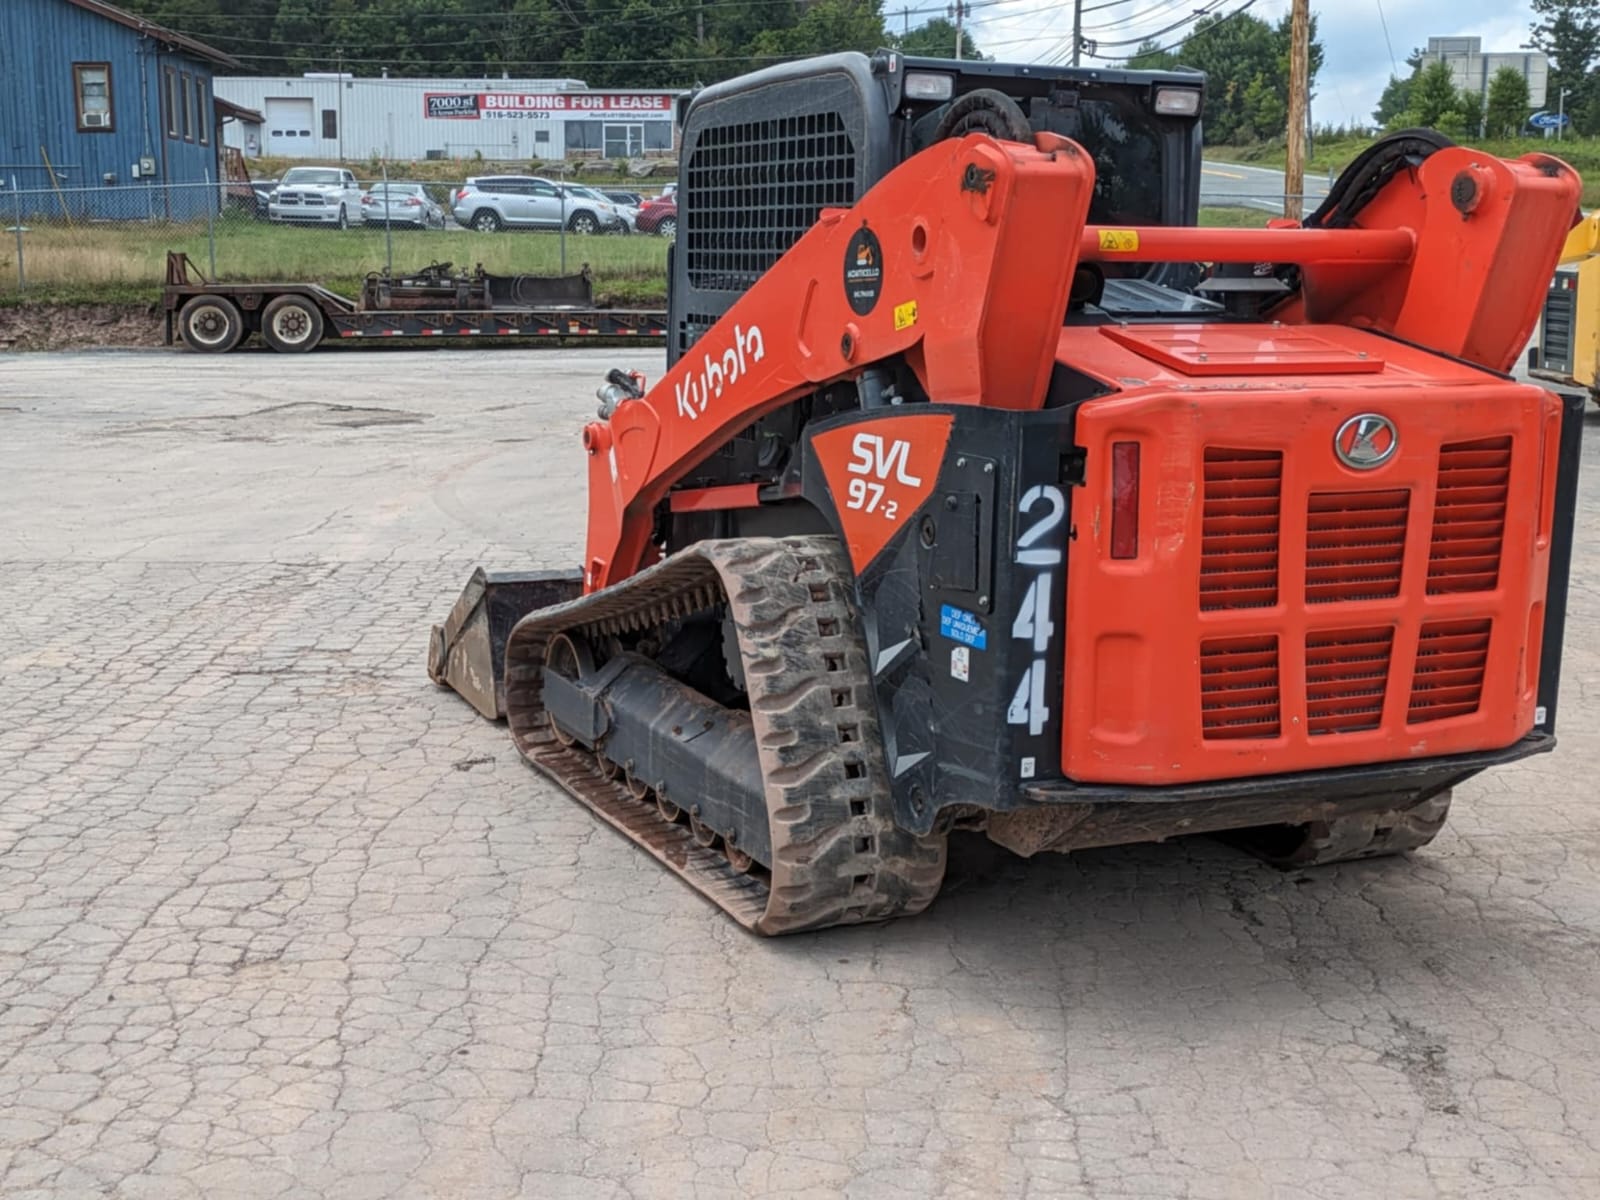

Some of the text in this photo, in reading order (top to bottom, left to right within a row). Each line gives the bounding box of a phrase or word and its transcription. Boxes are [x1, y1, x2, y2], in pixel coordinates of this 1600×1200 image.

[430, 97, 461, 108] 7000
[486, 95, 663, 109] BUILDING FOR LEASE
[486, 111, 550, 119] 516-523-5573
[674, 324, 765, 421] Kubota
[847, 432, 921, 488] SVL
[1007, 484, 1065, 736] 244
